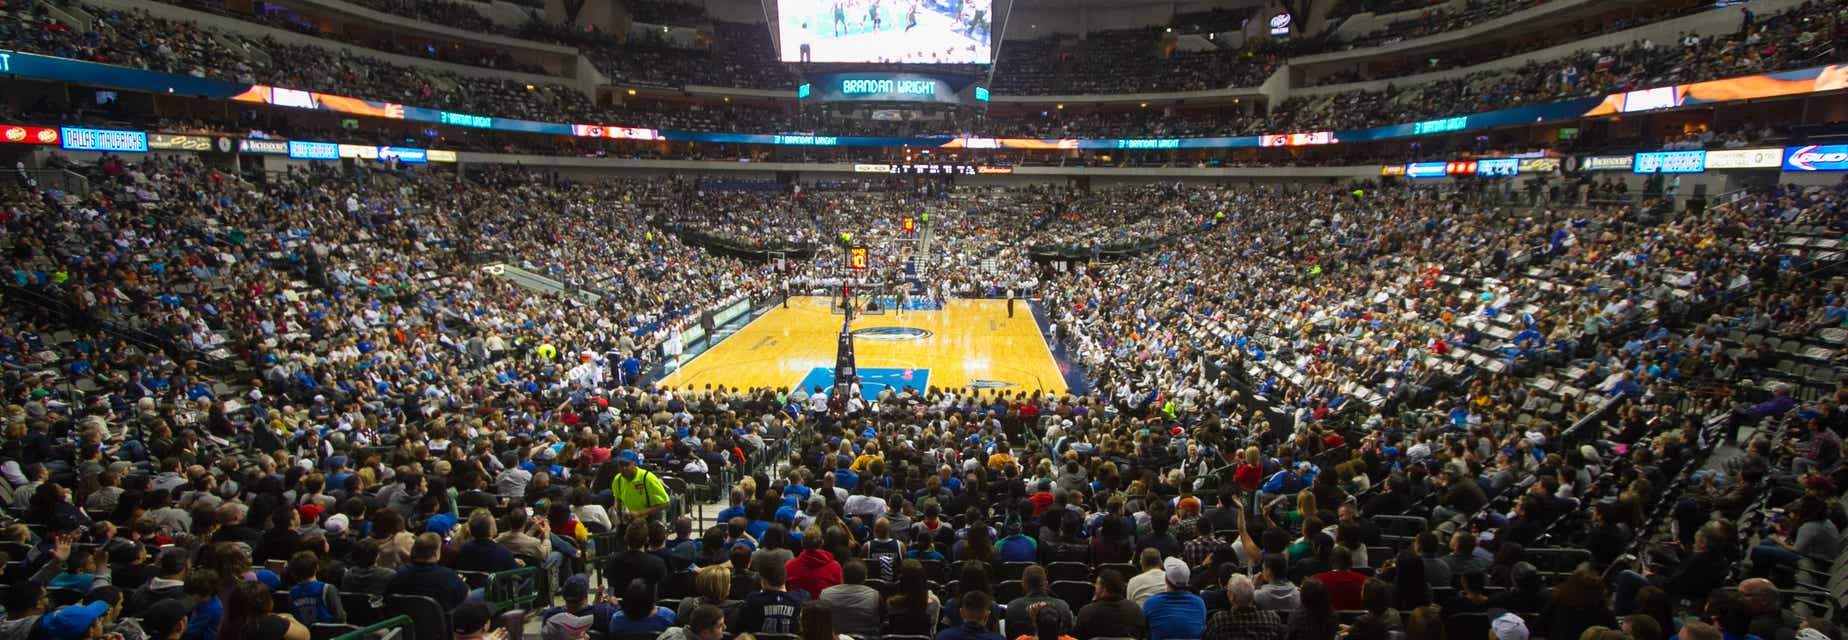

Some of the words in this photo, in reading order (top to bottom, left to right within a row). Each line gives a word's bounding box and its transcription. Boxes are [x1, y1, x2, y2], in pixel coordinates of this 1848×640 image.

[843, 80, 893, 94] BRANDAN
[897, 81, 936, 95] WRIGHT
[66, 130, 96, 147] DALLAS
[99, 132, 143, 149] MAVERICKS
